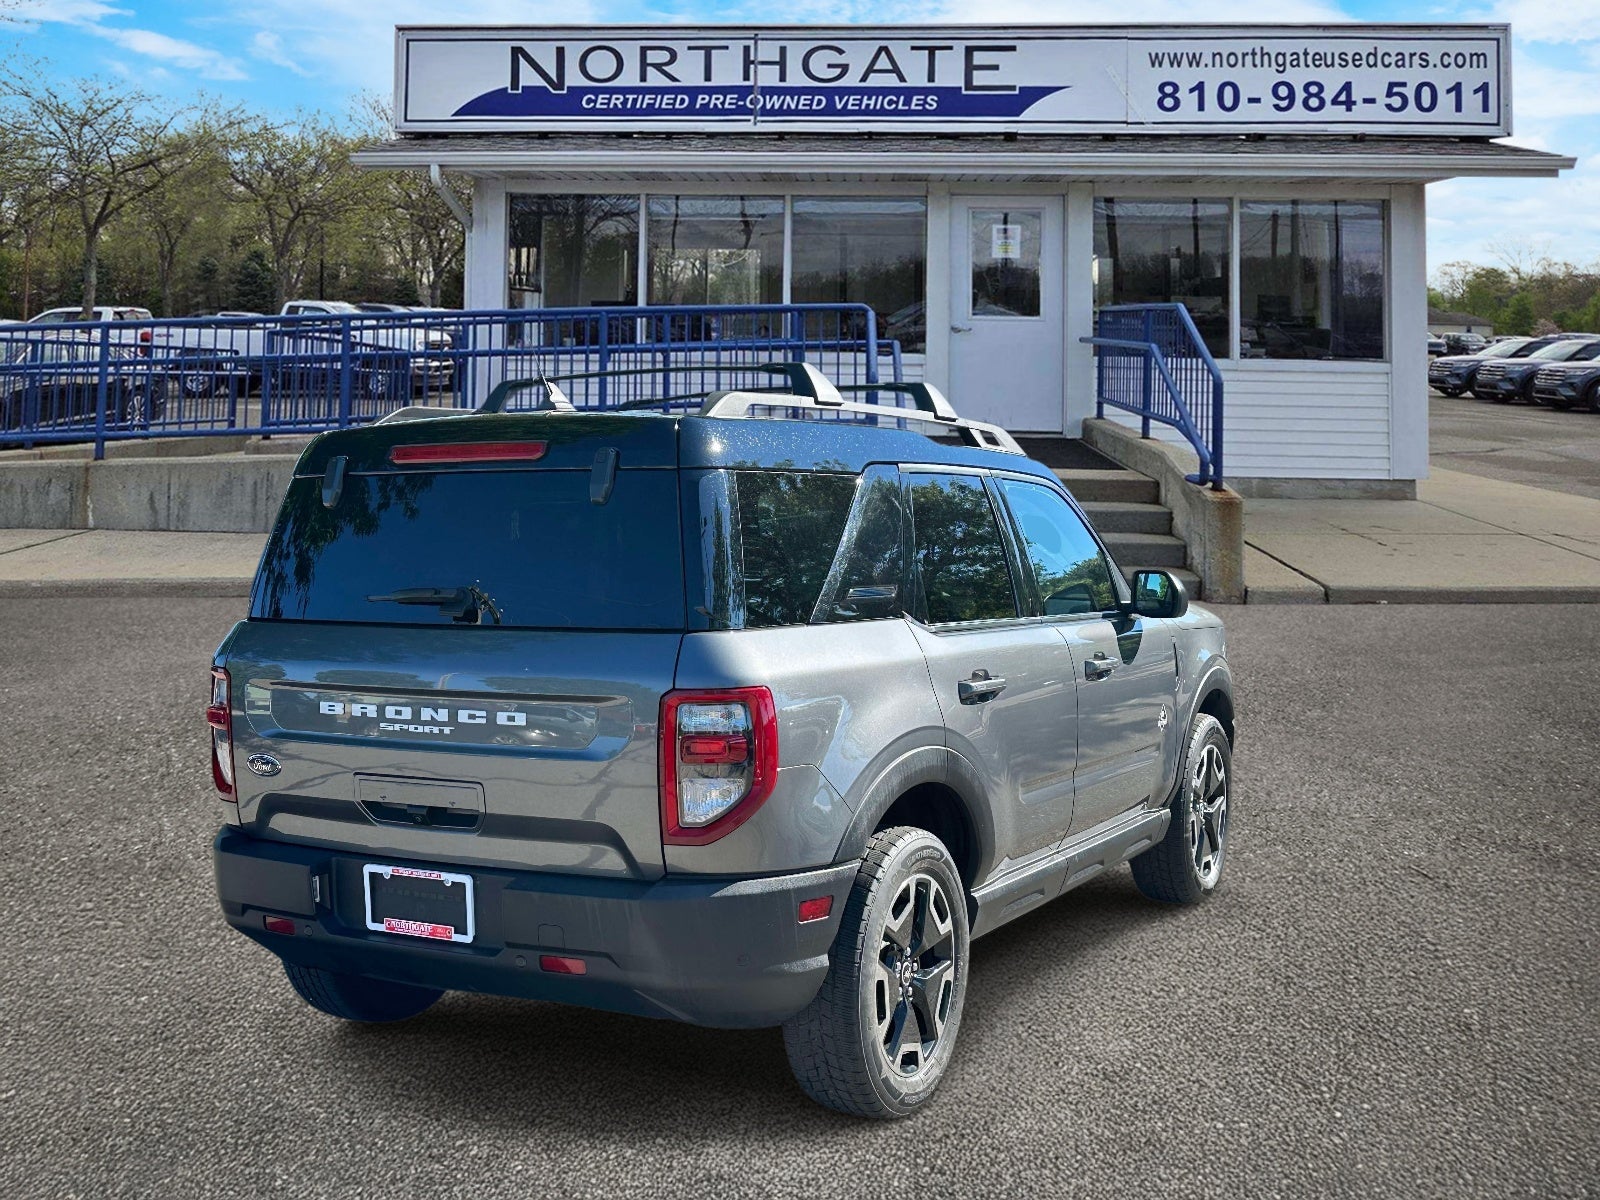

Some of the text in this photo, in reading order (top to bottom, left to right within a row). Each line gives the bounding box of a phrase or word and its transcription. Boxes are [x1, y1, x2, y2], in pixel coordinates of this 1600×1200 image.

[510, 44, 1017, 91] NORTHGATE
[1148, 46, 1488, 73] www.northgateusedcars.com
[581, 94, 939, 110] CERTIFIED PRE-OWNED VEHICLES
[1156, 80, 1490, 113] 810-984-5011
[319, 701, 527, 726] BRONCO
[379, 722, 455, 734] SPORT
